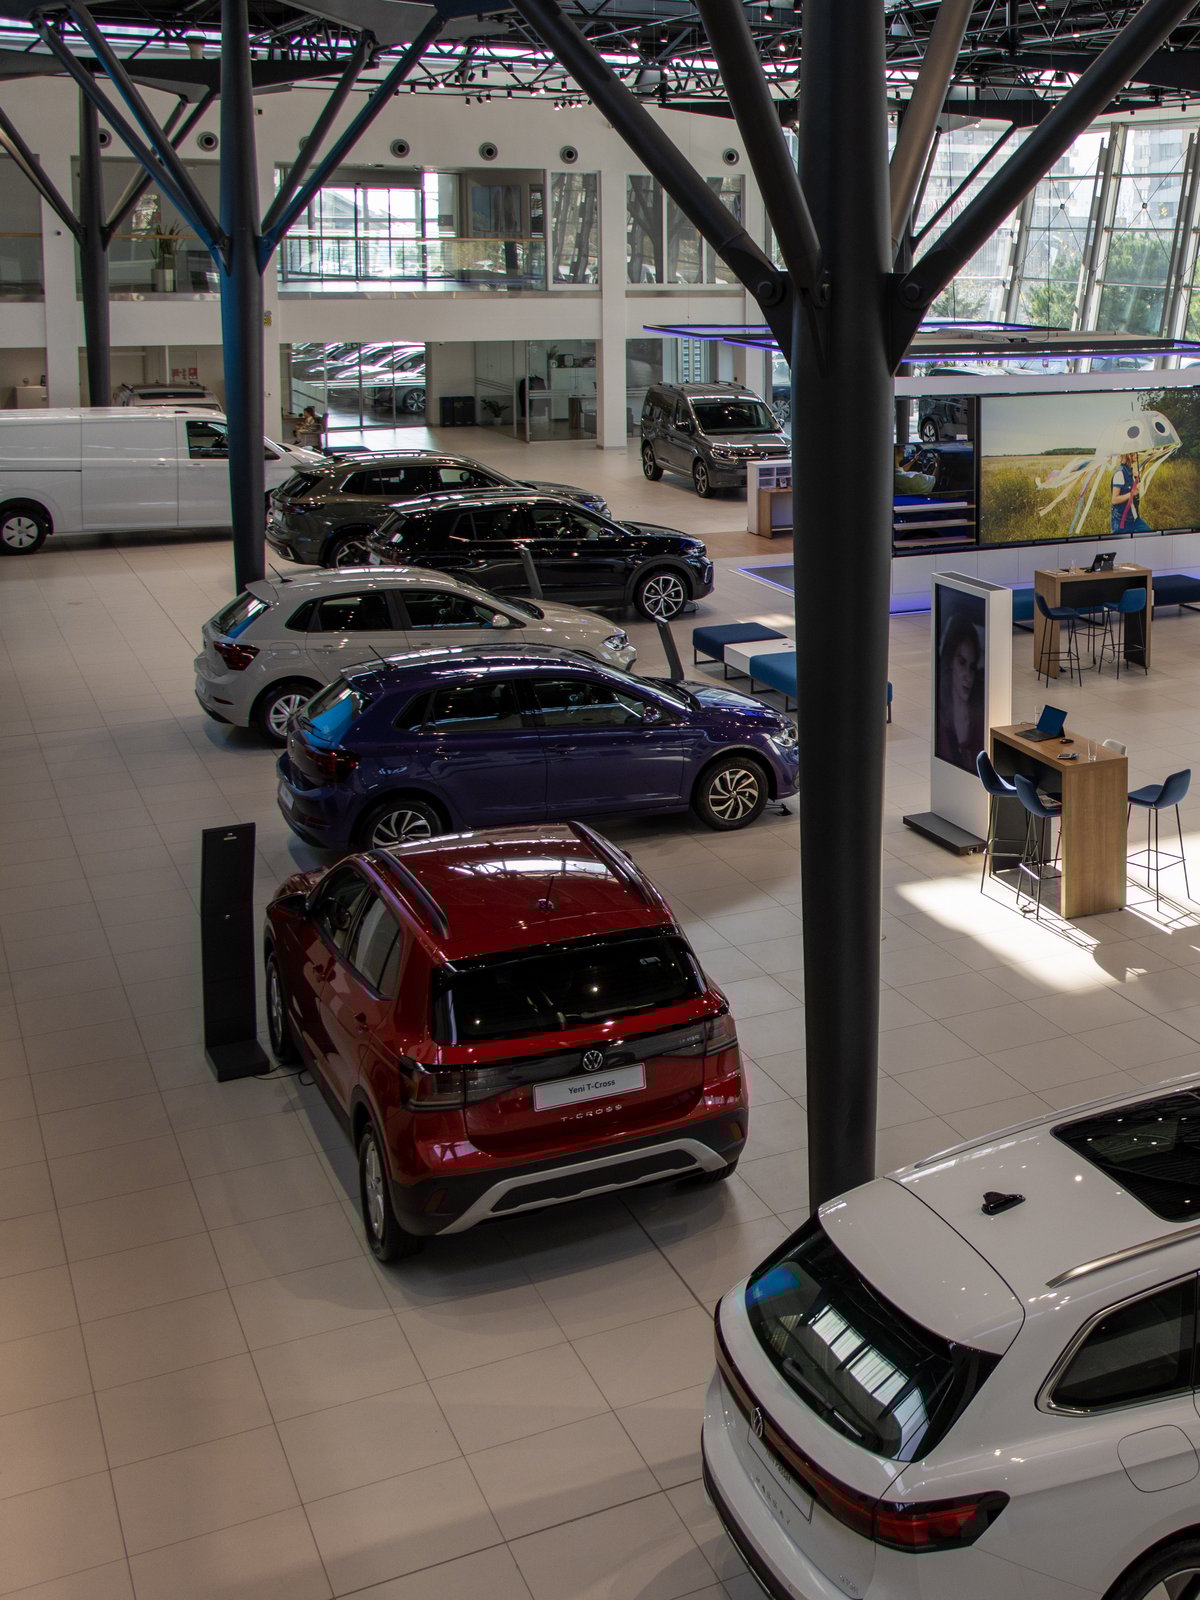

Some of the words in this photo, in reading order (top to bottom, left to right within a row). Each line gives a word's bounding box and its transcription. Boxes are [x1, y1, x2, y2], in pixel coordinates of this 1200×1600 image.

[568, 1085, 585, 1095] Yeni
[586, 1078, 616, 1092] T-Cross
[561, 1103, 623, 1122] T-CROSS
